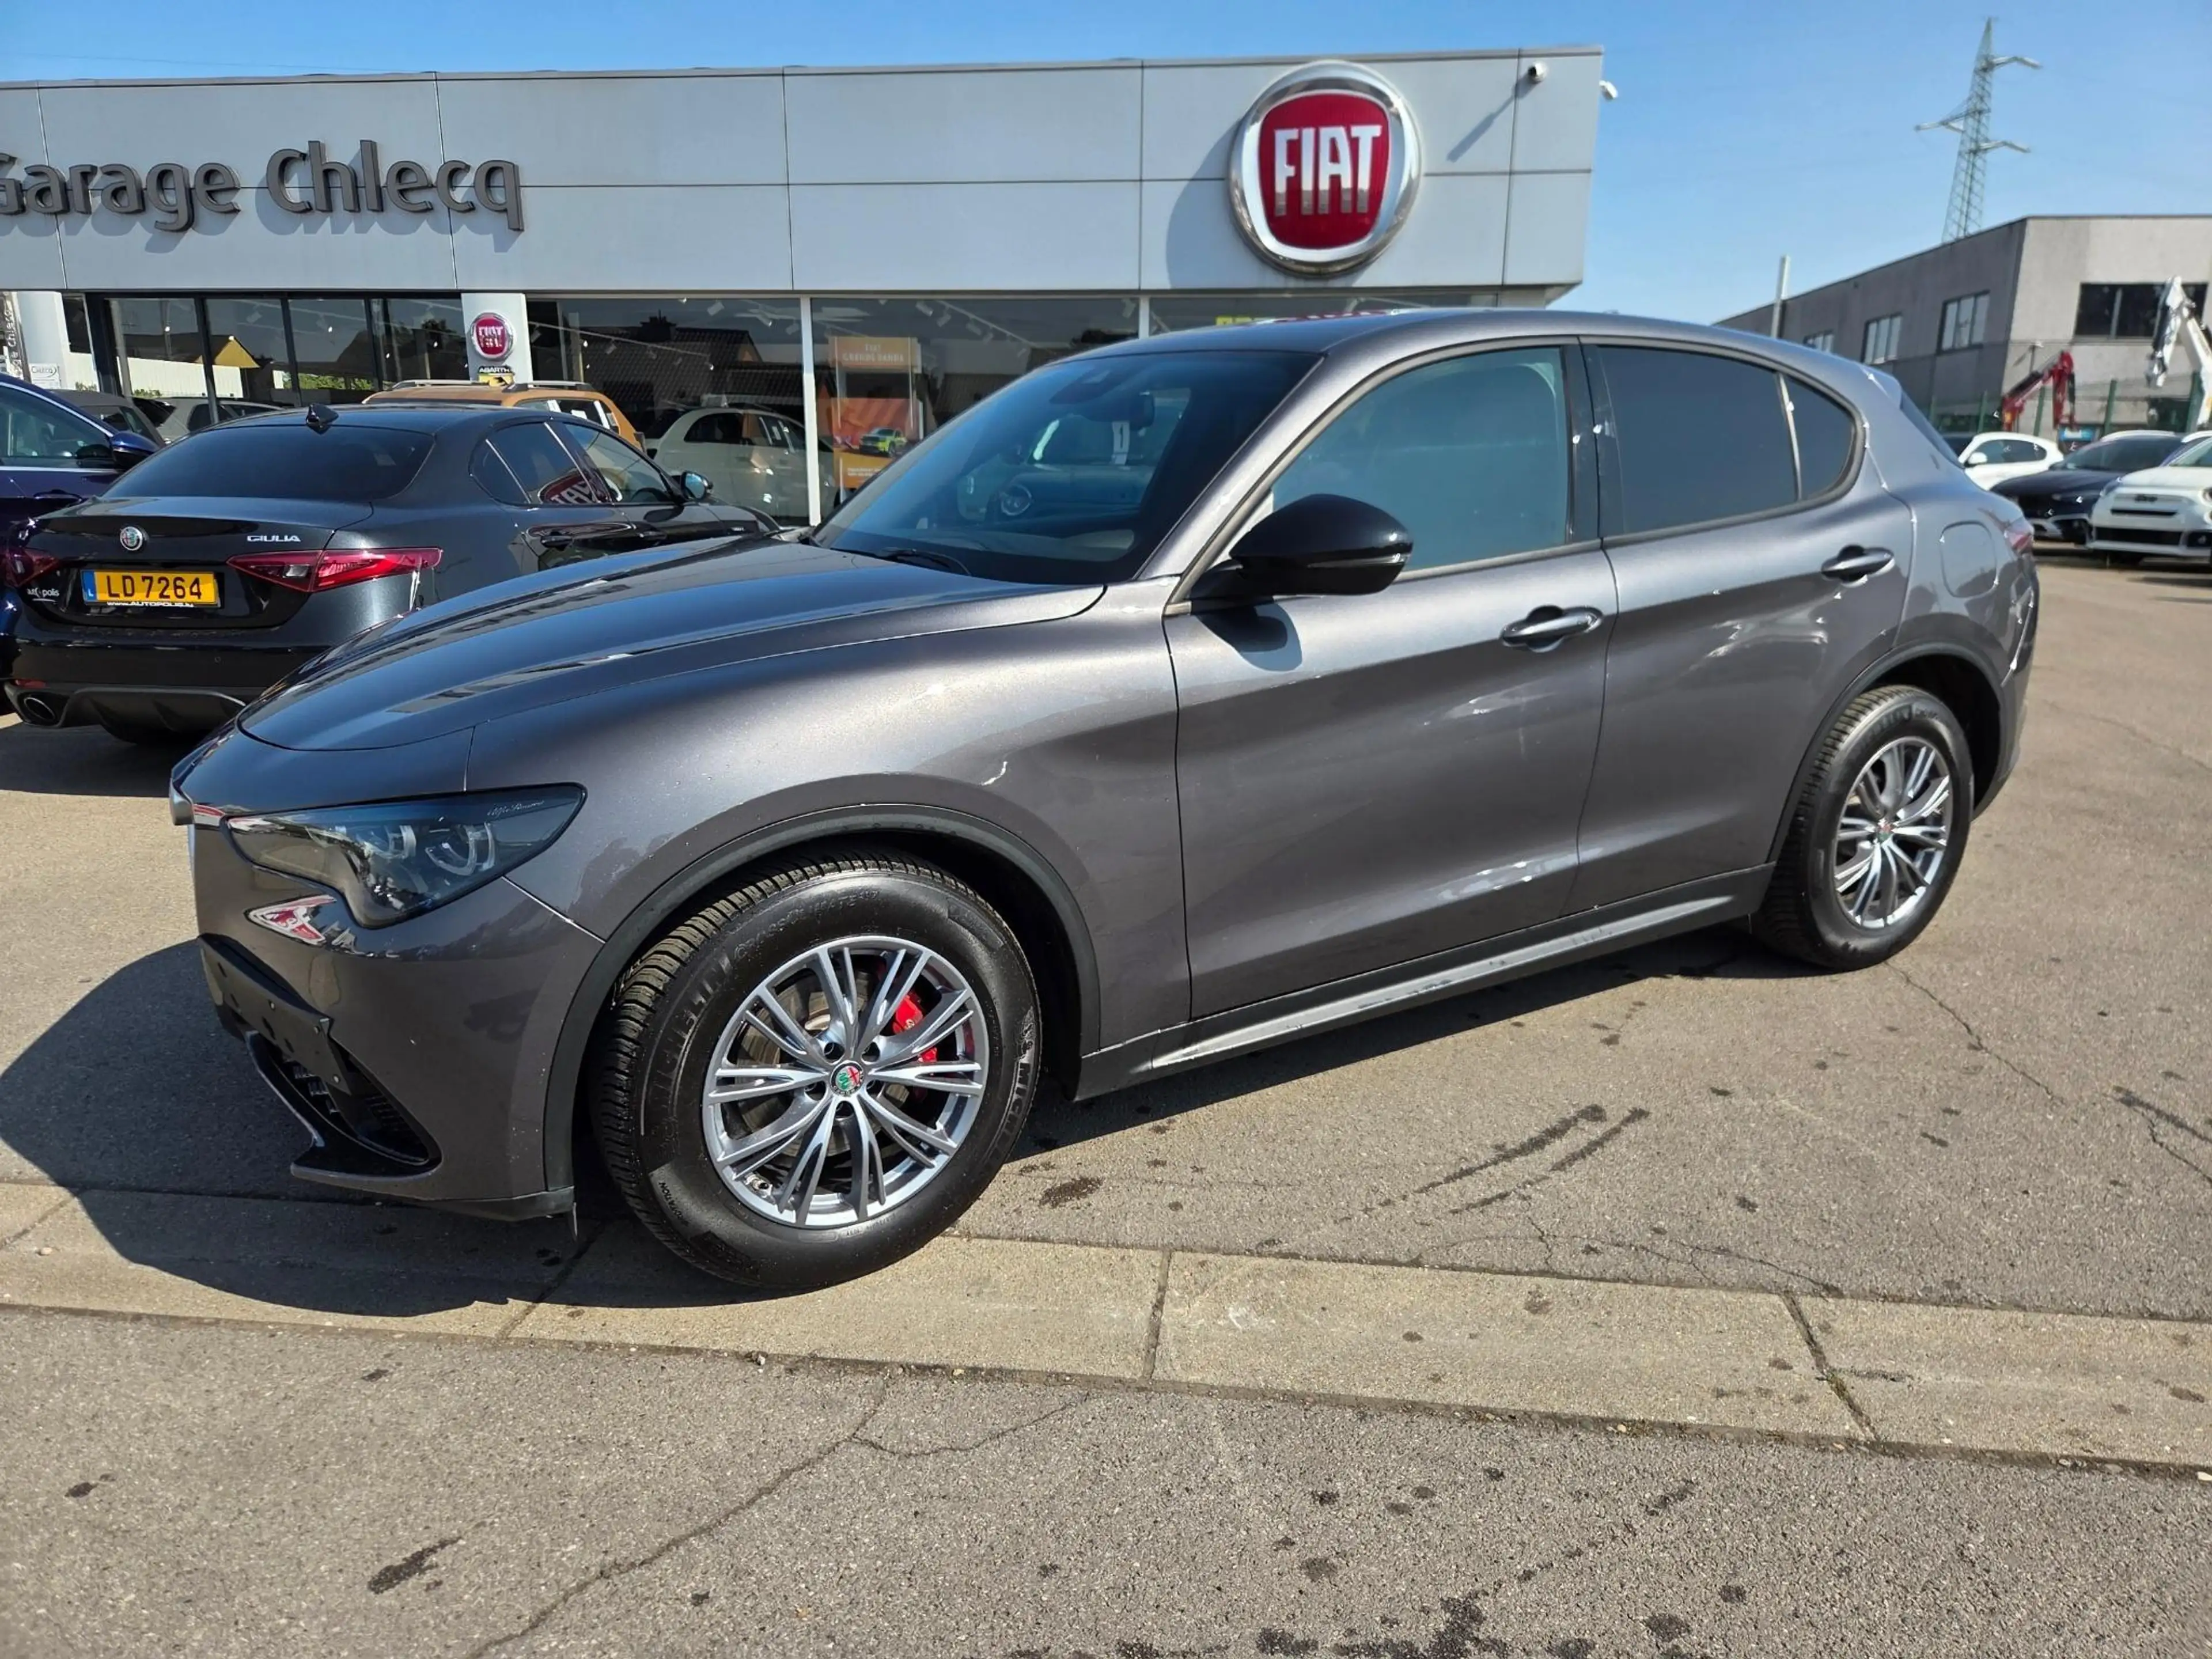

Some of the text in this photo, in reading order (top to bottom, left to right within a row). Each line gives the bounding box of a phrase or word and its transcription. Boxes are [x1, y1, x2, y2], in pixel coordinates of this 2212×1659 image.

[266, 139, 524, 232] Chlecq
[1274, 125, 1381, 215] FIAT
[478, 325, 503, 347] FIAT
[88, 575, 202, 600] L LD 7264
